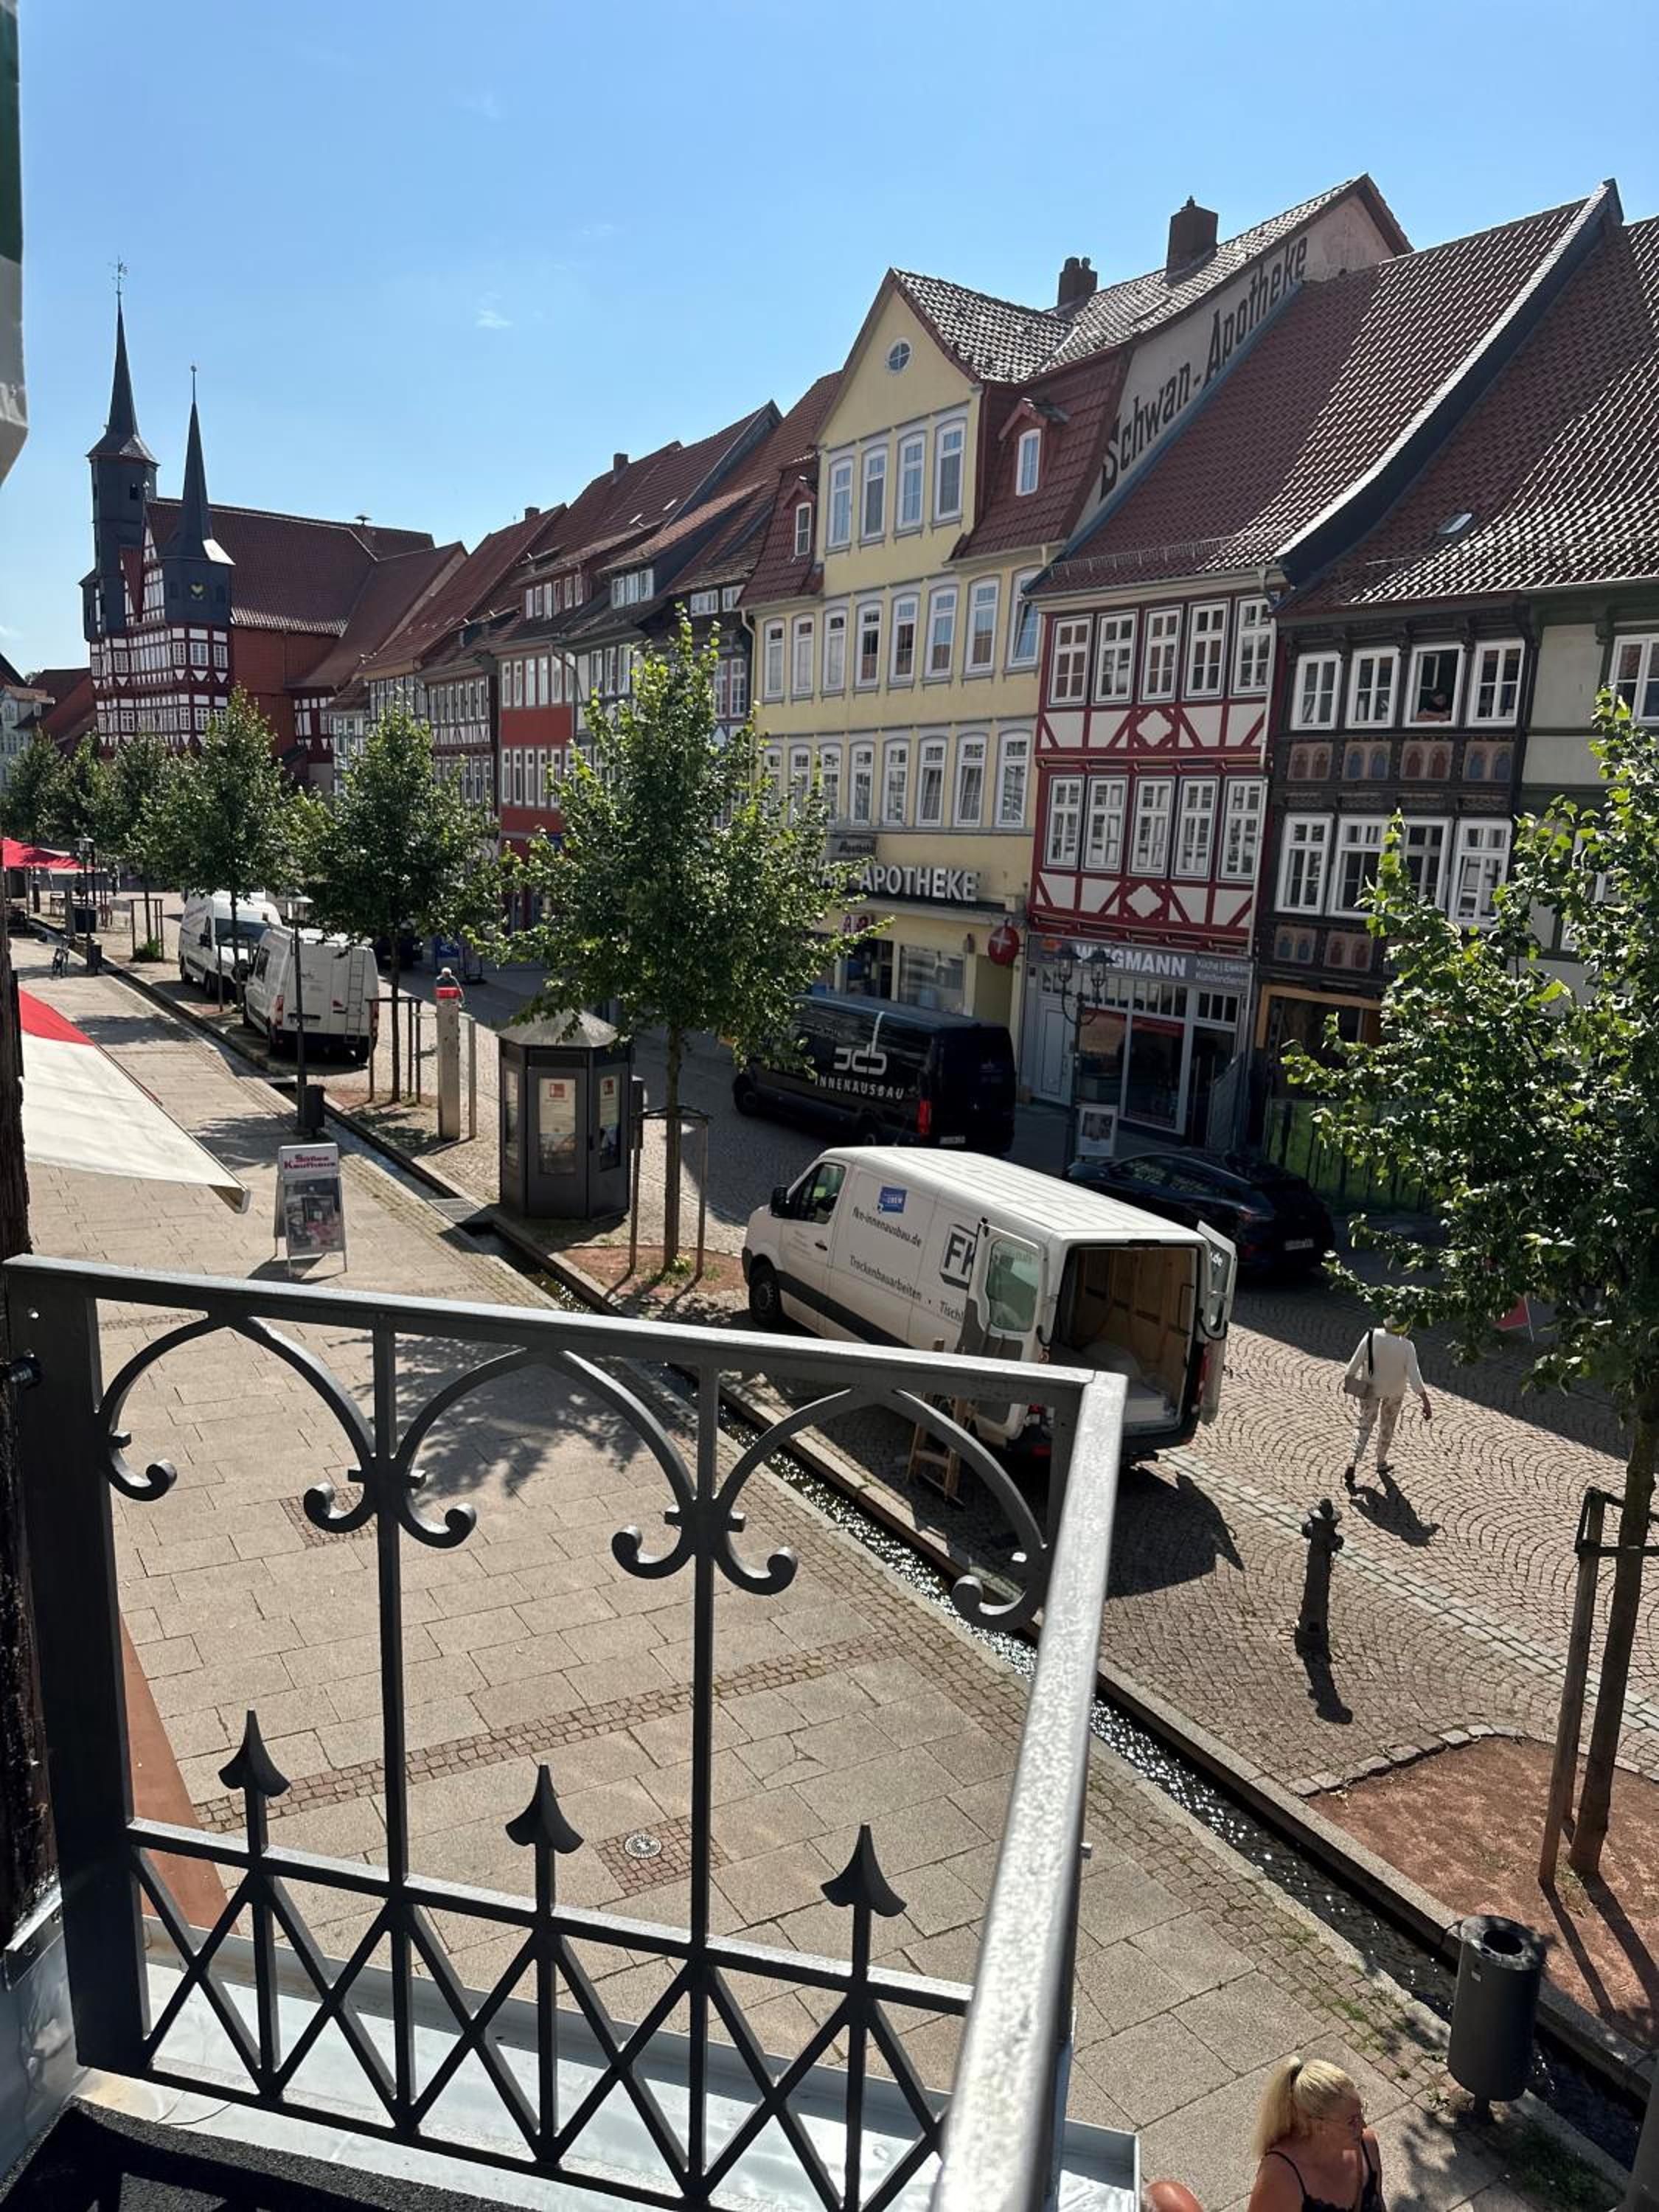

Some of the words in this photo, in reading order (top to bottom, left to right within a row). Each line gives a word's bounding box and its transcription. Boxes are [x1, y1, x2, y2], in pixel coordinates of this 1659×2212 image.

[859, 865, 977, 902] APOTHEKE
[1075, 944, 1186, 977] WGMANN
[814, 1074, 905, 1100] INNENAUSBAU
[849, 1253, 922, 1301] Trockenbauarbeiten
